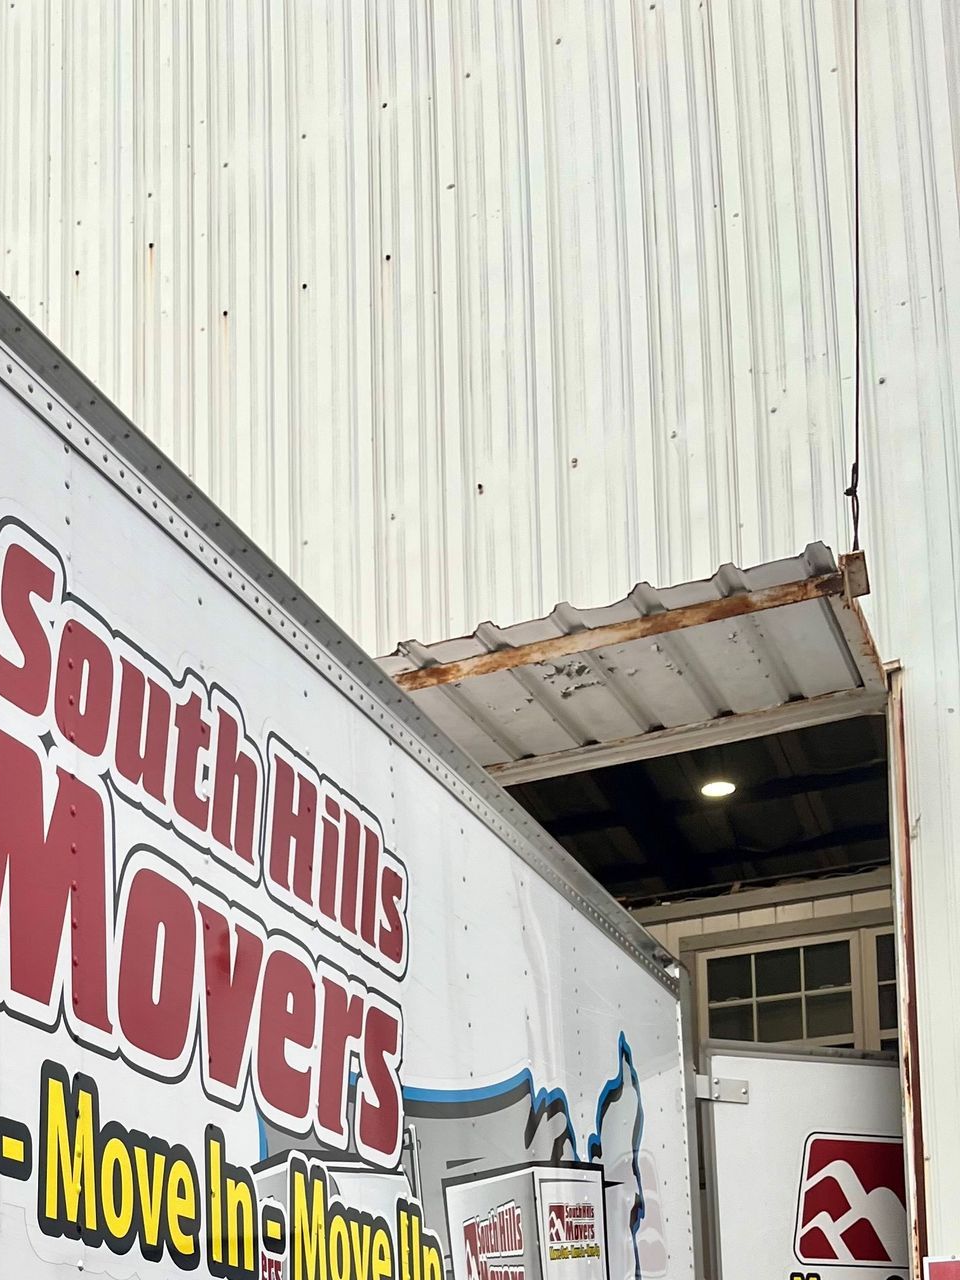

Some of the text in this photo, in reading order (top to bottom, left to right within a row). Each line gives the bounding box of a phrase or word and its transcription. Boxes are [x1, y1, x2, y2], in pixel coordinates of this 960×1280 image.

[268, 753, 404, 964] Hills
[44, 1078, 196, 1256] Move
[208, 1139, 255, 1272] In
[497, 1205, 524, 1253] Hills
[565, 1220, 595, 1240] Movers
